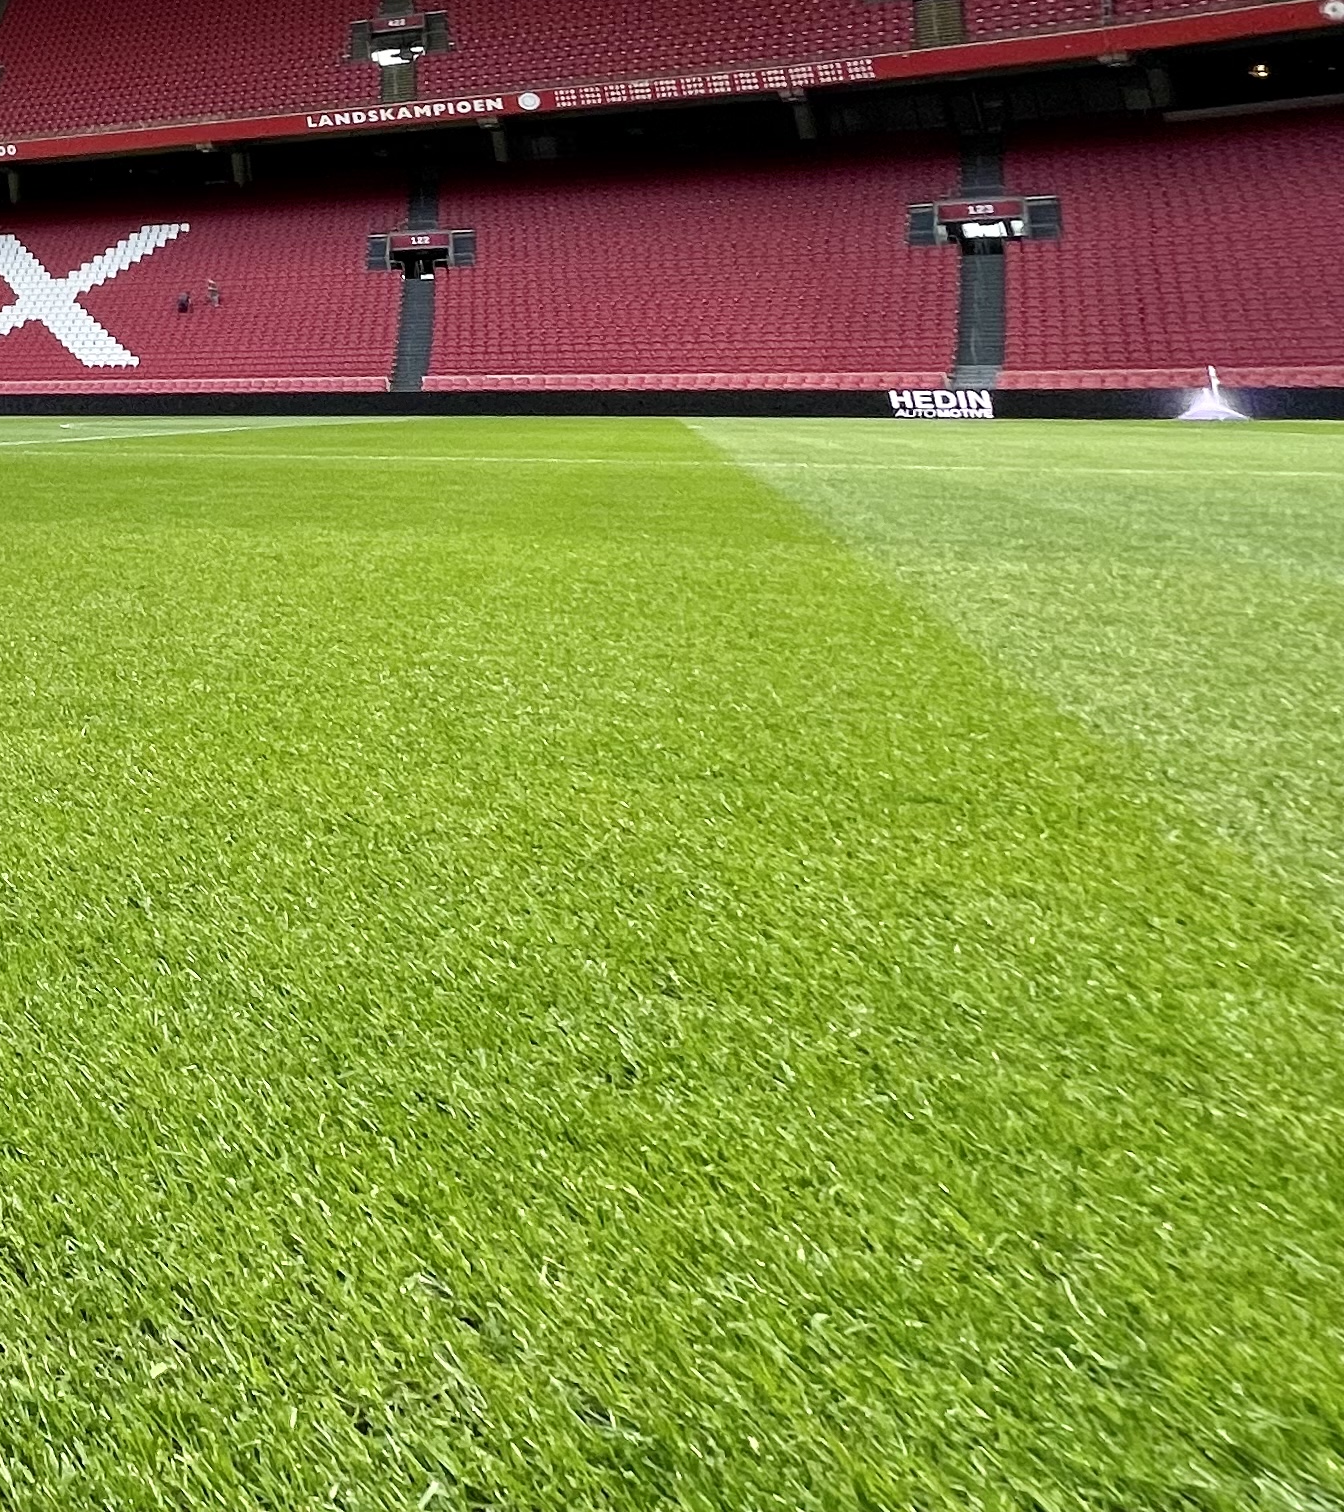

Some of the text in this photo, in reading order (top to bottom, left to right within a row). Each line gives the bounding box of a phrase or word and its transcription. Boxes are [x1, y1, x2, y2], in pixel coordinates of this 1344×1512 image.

[306, 97, 504, 129] LANDSKAMPIOEN
[967, 204, 995, 215] 123
[410, 235, 431, 245] 122
[888, 389, 992, 409] HEDIN
[894, 408, 995, 418] AUTOMOTIVE
